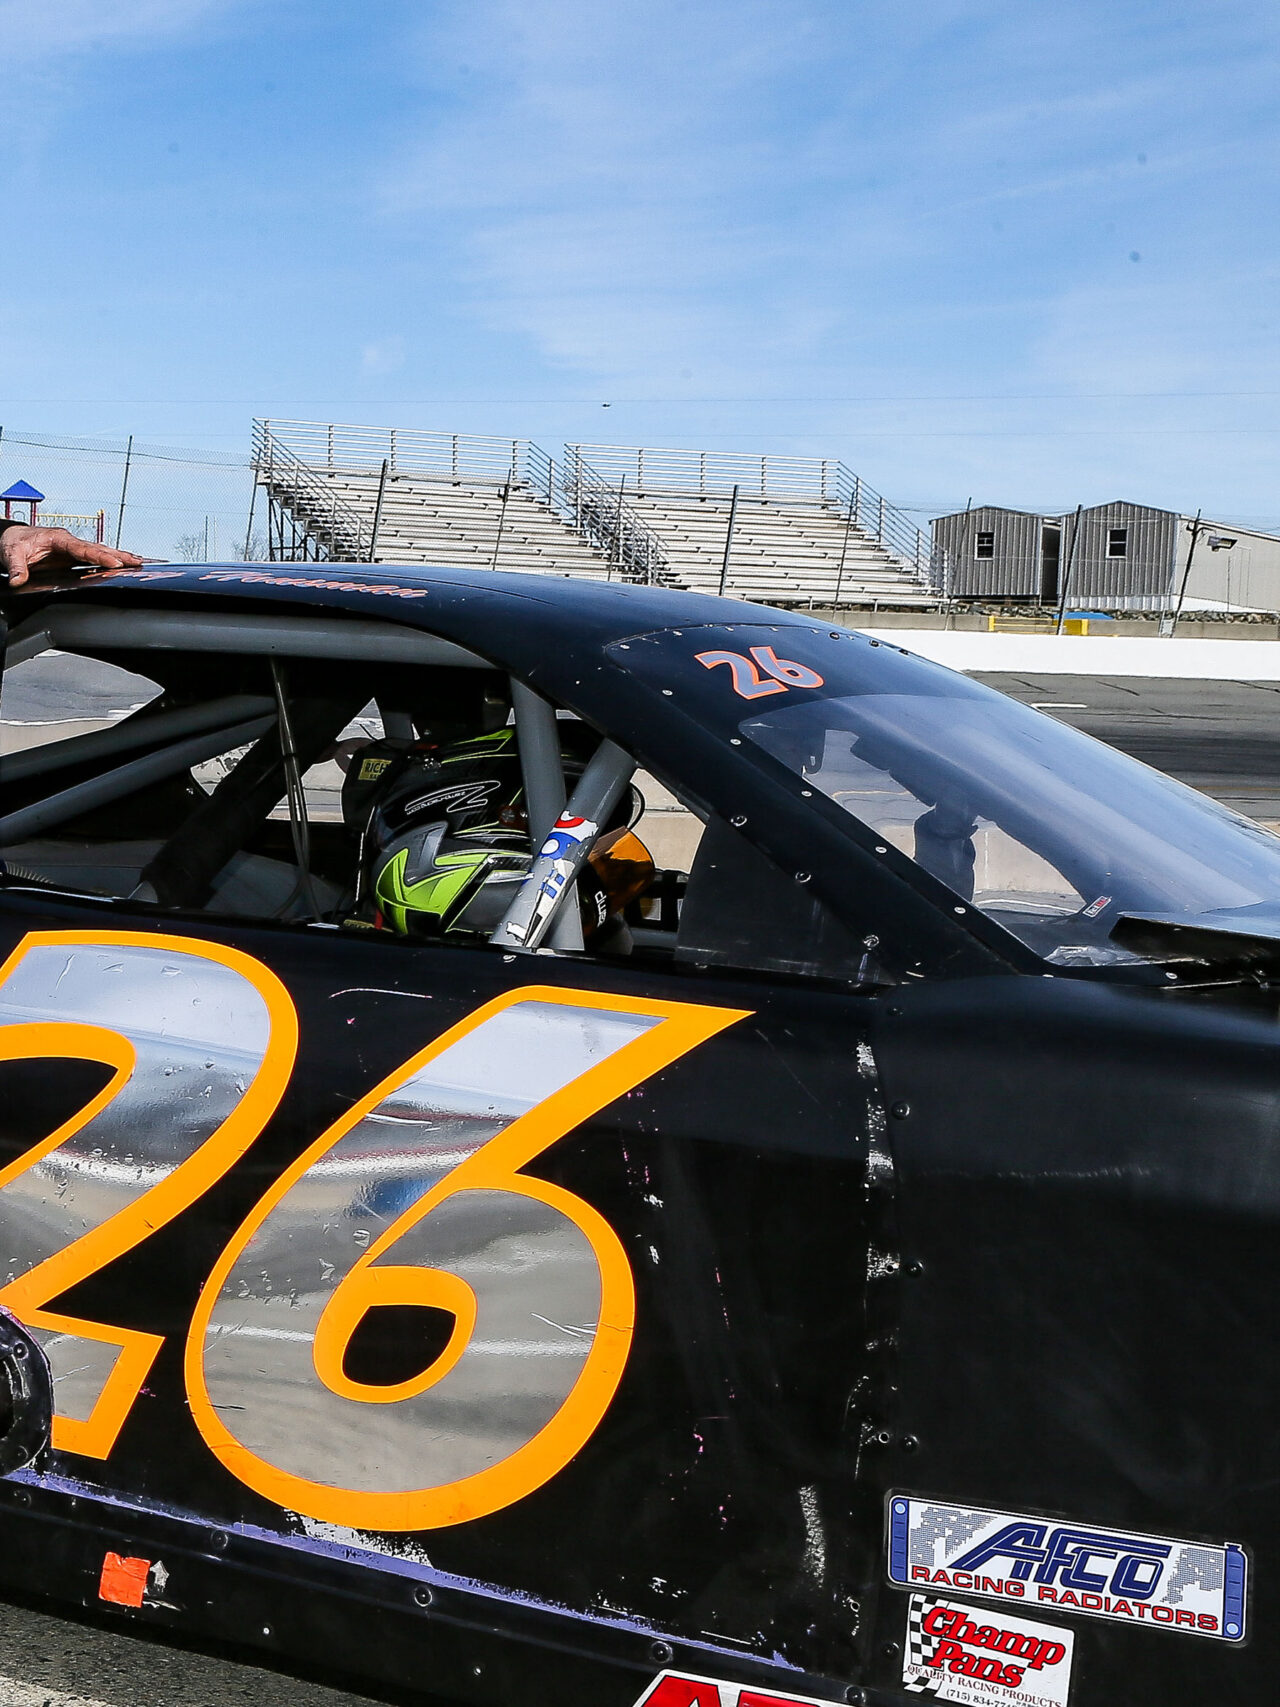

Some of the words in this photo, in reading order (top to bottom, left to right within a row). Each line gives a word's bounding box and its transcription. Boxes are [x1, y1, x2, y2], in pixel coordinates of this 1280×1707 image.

[694, 645, 824, 700] 26
[947, 1521, 1173, 1600] AFCO
[911, 1565, 1025, 1597] RACING
[1038, 1585, 1219, 1631] RADIATORS
[922, 1606, 1066, 1671] Champ
[926, 1639, 1026, 1688] Pans
[907, 1664, 956, 1684] QUALITY
[957, 1676, 1000, 1695] RACING
[1001, 1688, 1063, 1707] PRODUCTS
[945, 1688, 971, 1703] (715)
